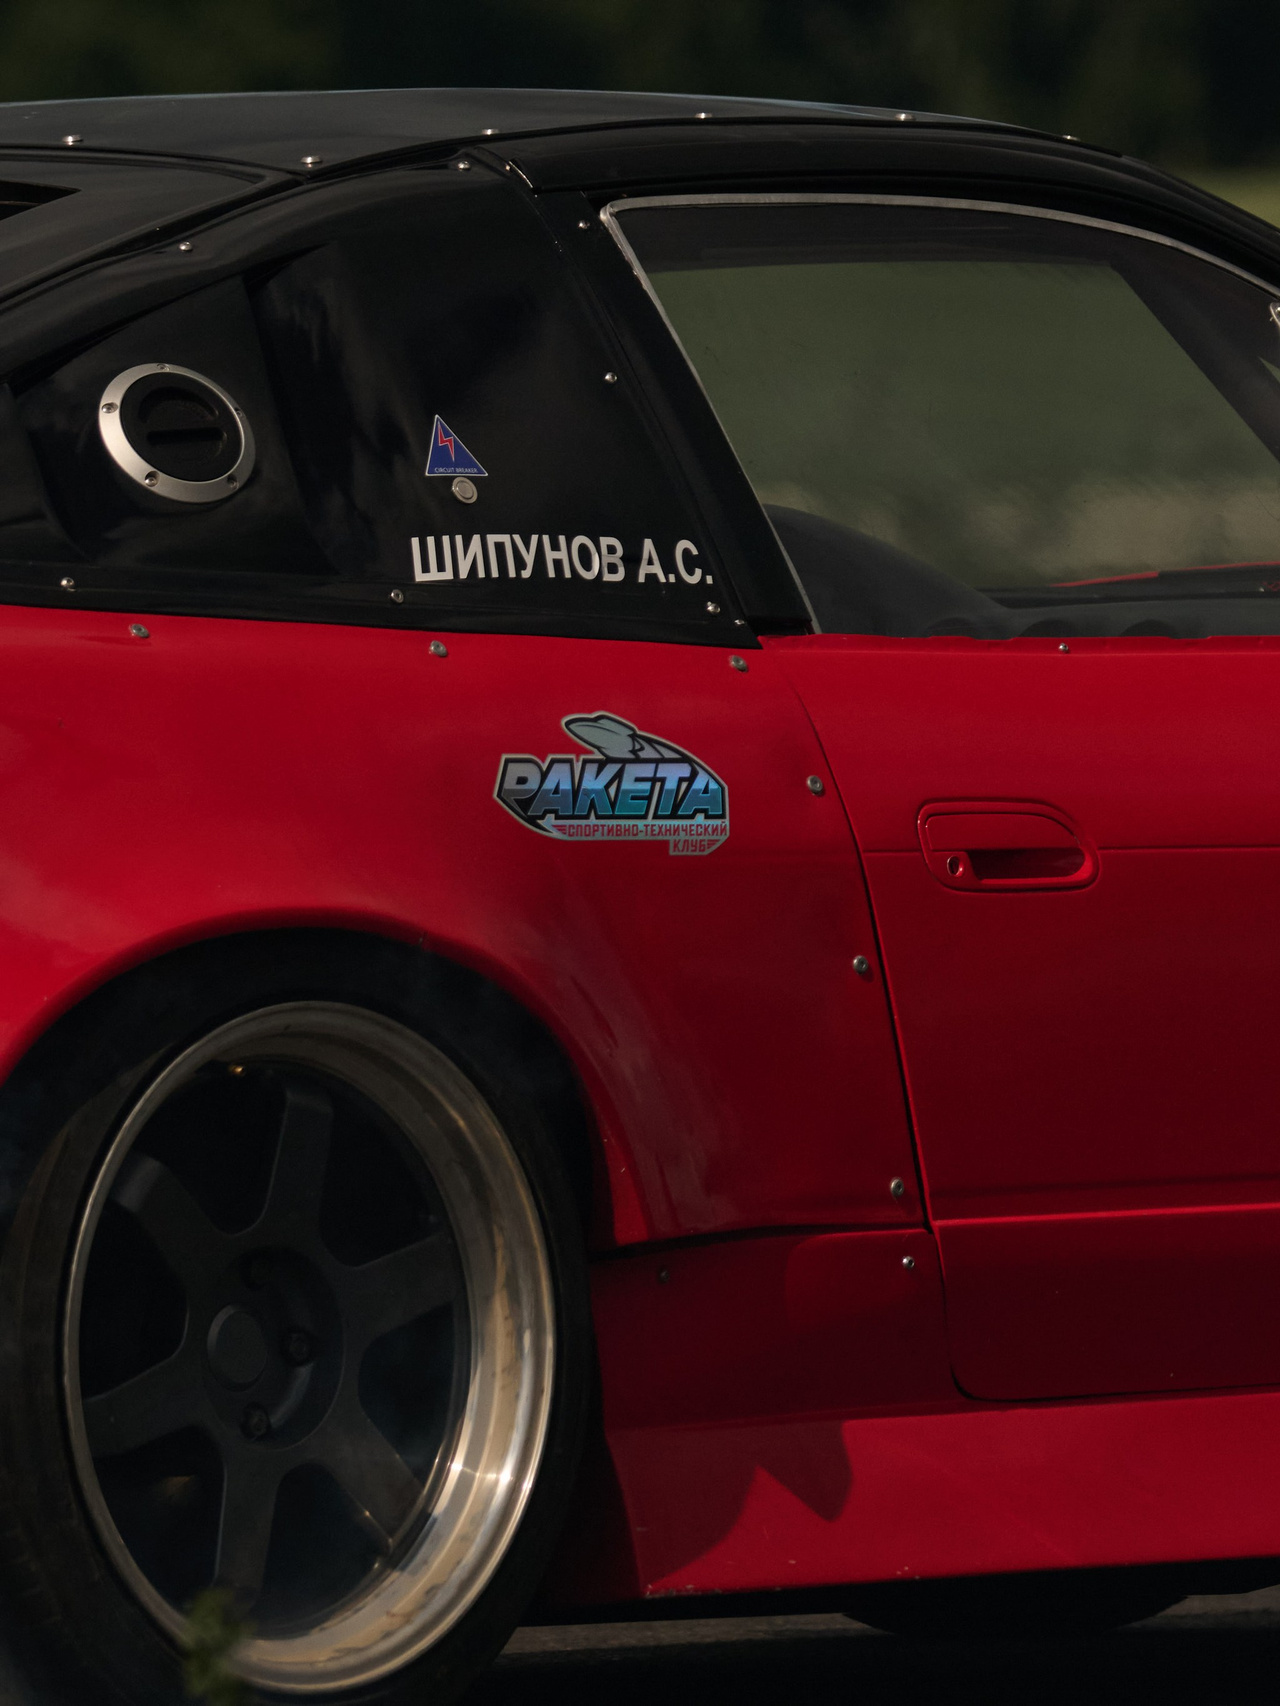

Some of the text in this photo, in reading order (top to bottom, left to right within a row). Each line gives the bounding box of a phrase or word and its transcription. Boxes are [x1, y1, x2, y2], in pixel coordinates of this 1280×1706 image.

[410, 533, 715, 585] ШИПУНОВ А.С.
[499, 760, 725, 819] РАКЕТА
[567, 821, 728, 837] СПОРТИВНО-ТЕХНИЧЕСКИЙ
[672, 839, 707, 853] КЛУБ
